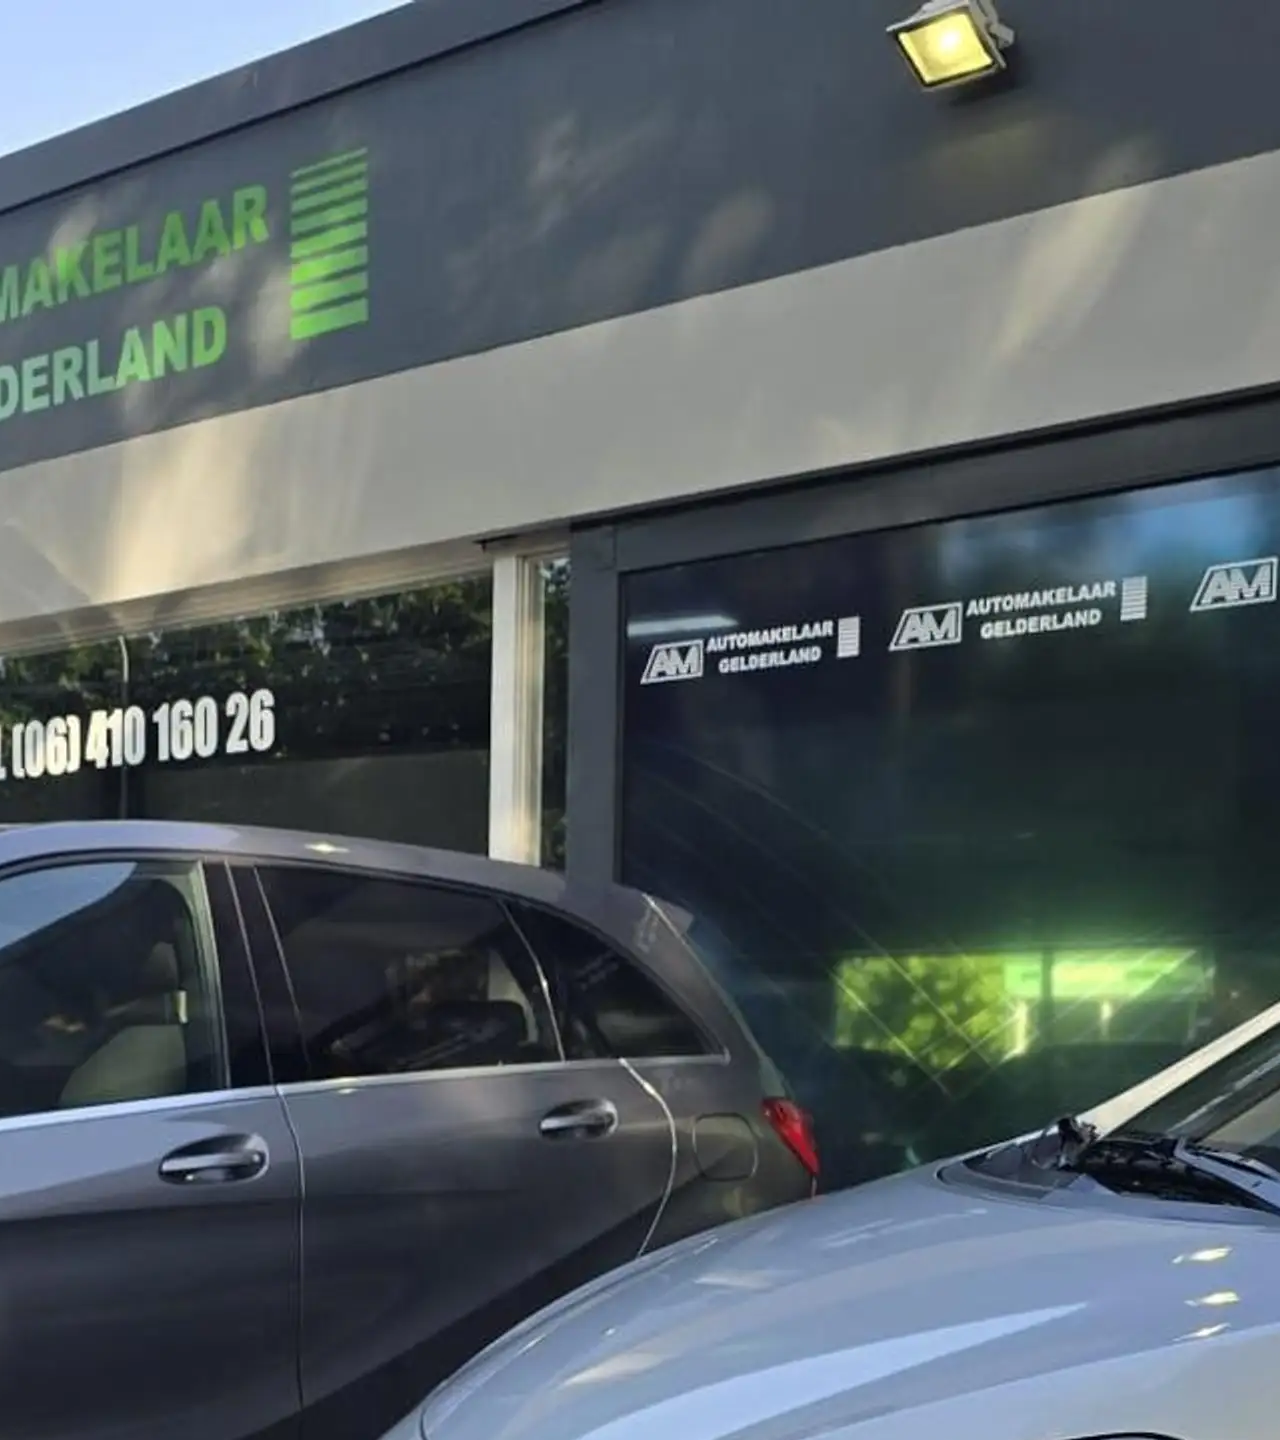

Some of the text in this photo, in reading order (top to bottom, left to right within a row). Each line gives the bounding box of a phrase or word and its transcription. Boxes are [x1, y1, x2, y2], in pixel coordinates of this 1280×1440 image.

[966, 580, 1117, 616] AUTOMAKELAAR
[1199, 564, 1272, 603] AM
[706, 620, 834, 652] AUTOMAKELAAR
[897, 611, 958, 647] AM
[980, 608, 1102, 641] GELDERLAND
[649, 643, 700, 679] AM
[719, 645, 821, 674] GELDERLAND
[12, 714, 80, 779] (06)
[85, 705, 146, 770] 410
[153, 696, 219, 762] 160
[226, 688, 276, 753] 26
